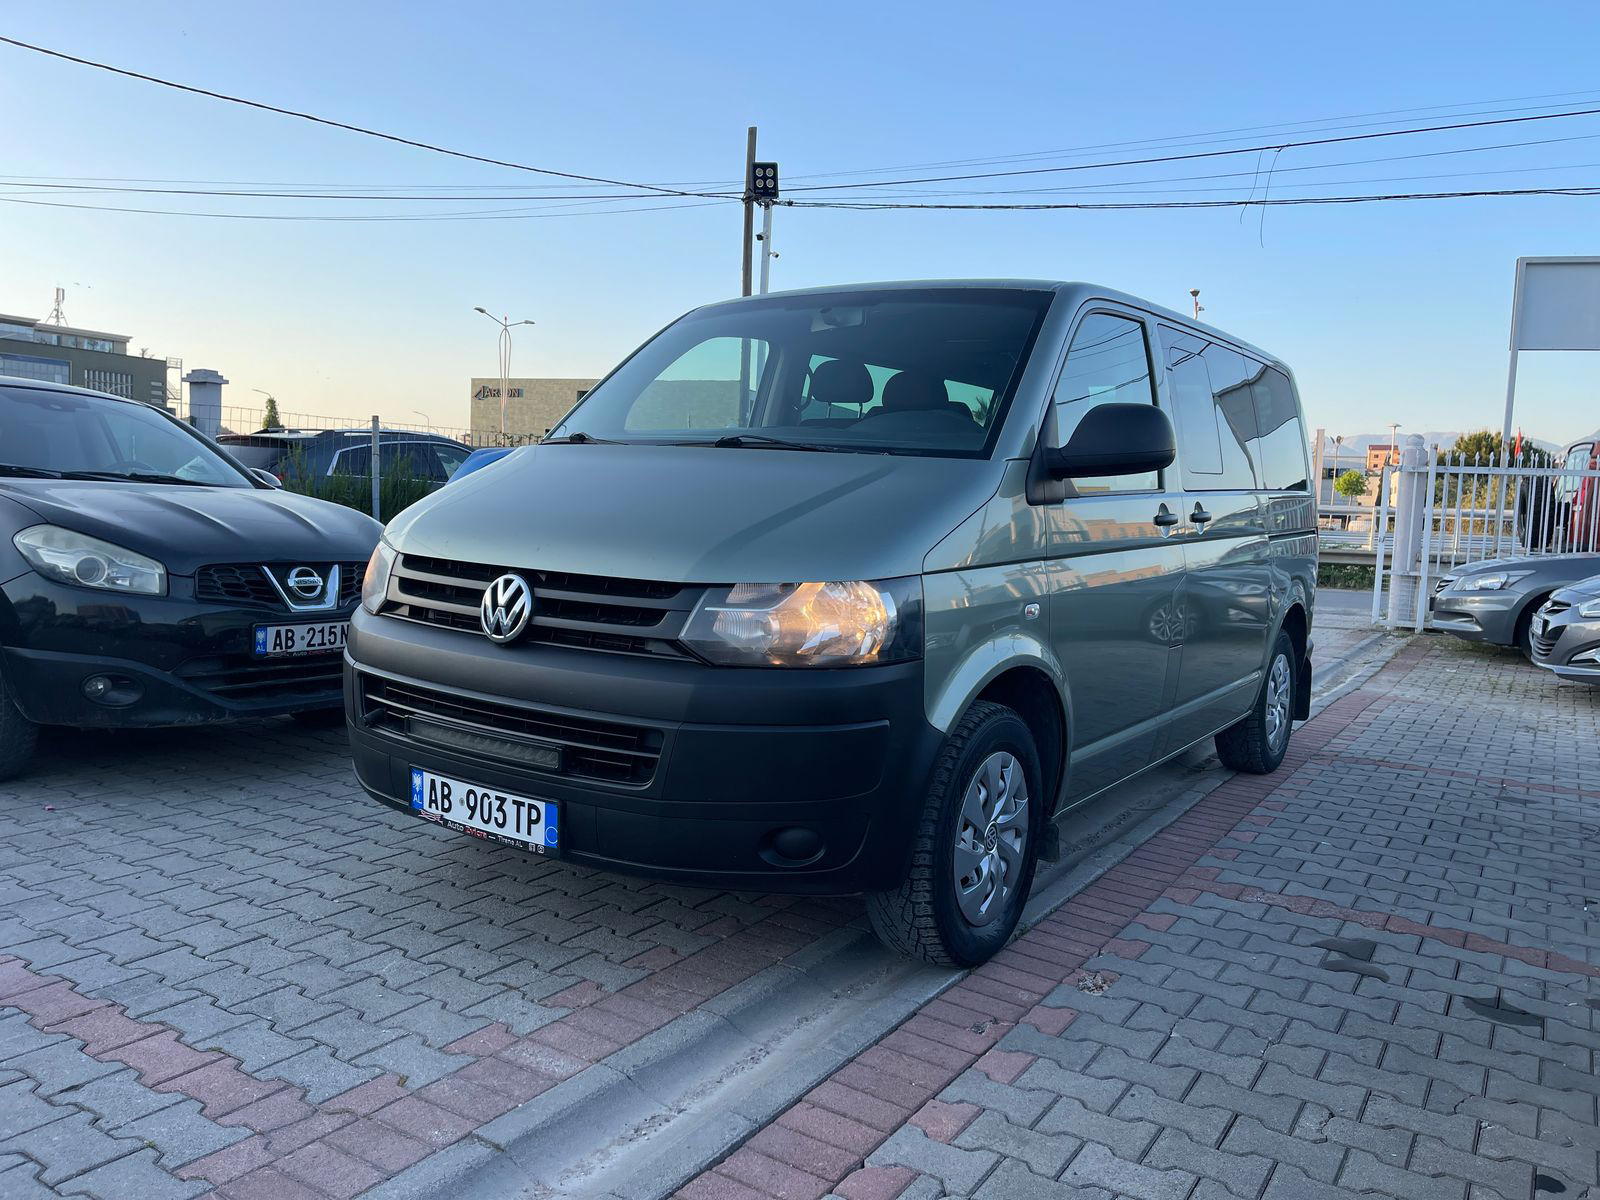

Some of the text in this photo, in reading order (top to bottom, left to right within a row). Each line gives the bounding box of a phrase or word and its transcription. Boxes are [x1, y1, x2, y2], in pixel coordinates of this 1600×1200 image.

[294, 578, 321, 586] NISSAN
[482, 574, 530, 642] VW
[272, 628, 295, 651] AB
[413, 793, 423, 804] AL
[429, 778, 452, 813] AB
[447, 820, 464, 832] Auto
